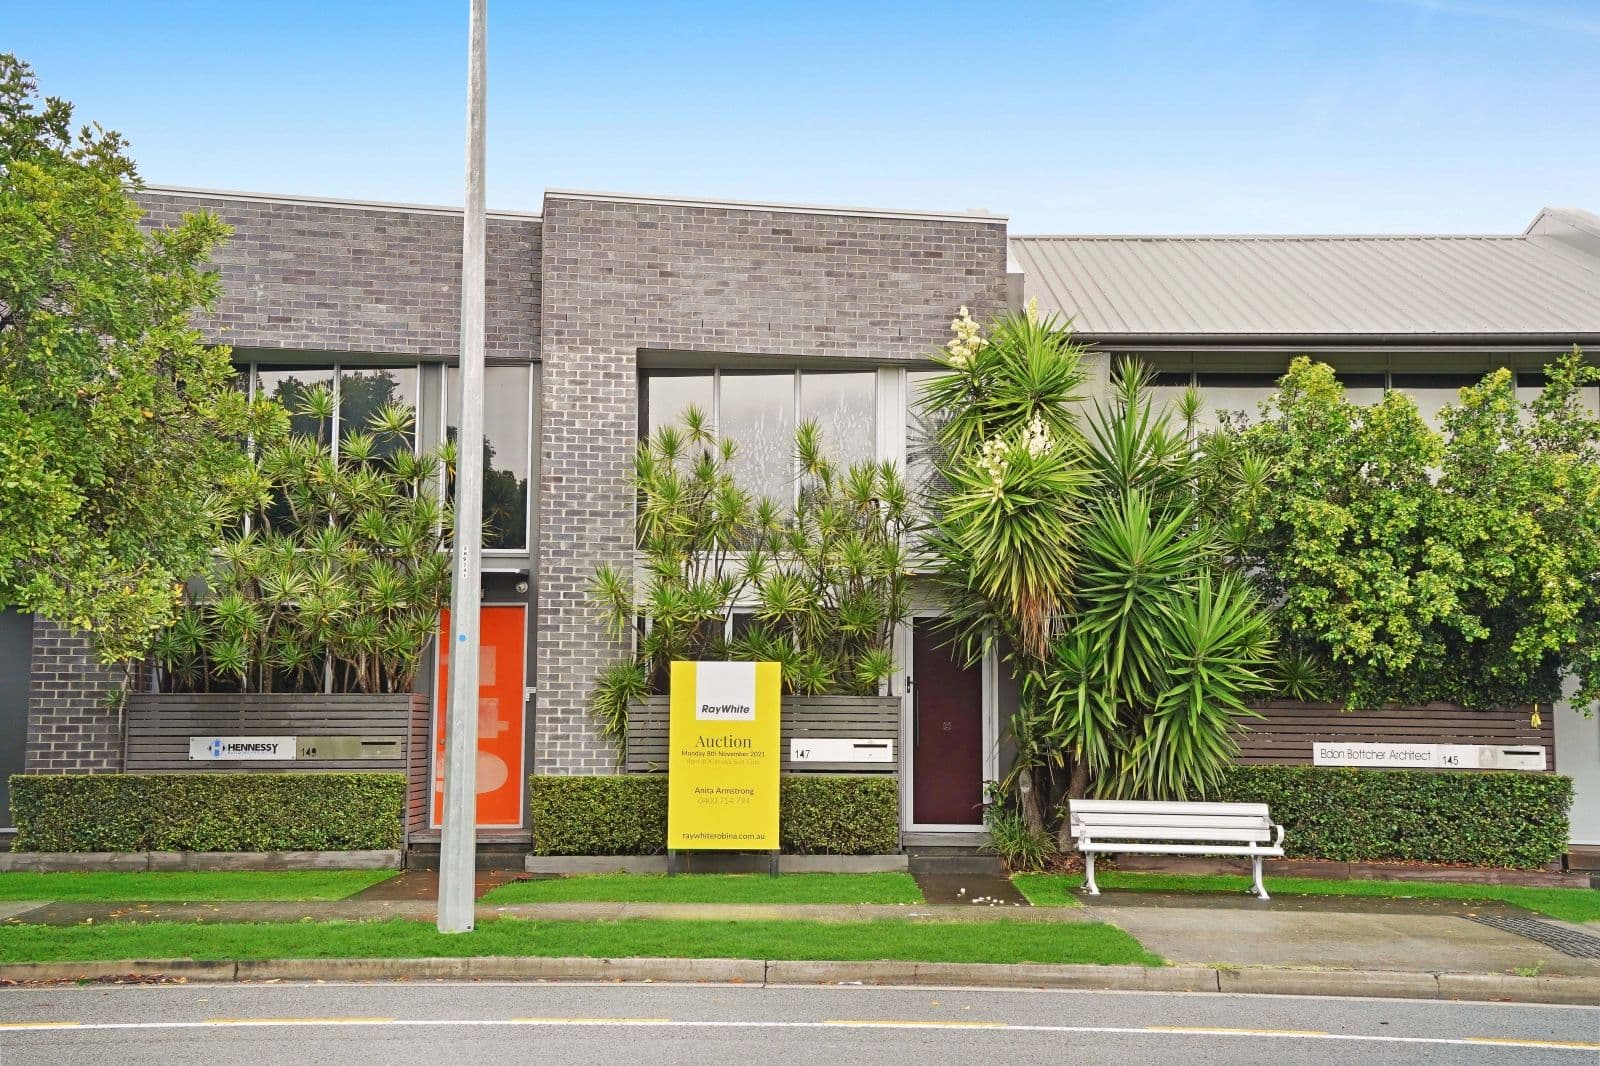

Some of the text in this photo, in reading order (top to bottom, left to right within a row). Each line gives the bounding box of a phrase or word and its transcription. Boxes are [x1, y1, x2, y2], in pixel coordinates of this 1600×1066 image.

[695, 734, 751, 748] Auction
[227, 743, 279, 754] HENNESSY
[681, 750, 705, 758] Monday
[795, 749, 811, 759] 147
[1389, 749, 1432, 761] Architect
[1442, 755, 1459, 765] 145
[694, 786, 755, 796] Anita Armstrong
[682, 832, 765, 841] raywhiterobina.com.au
